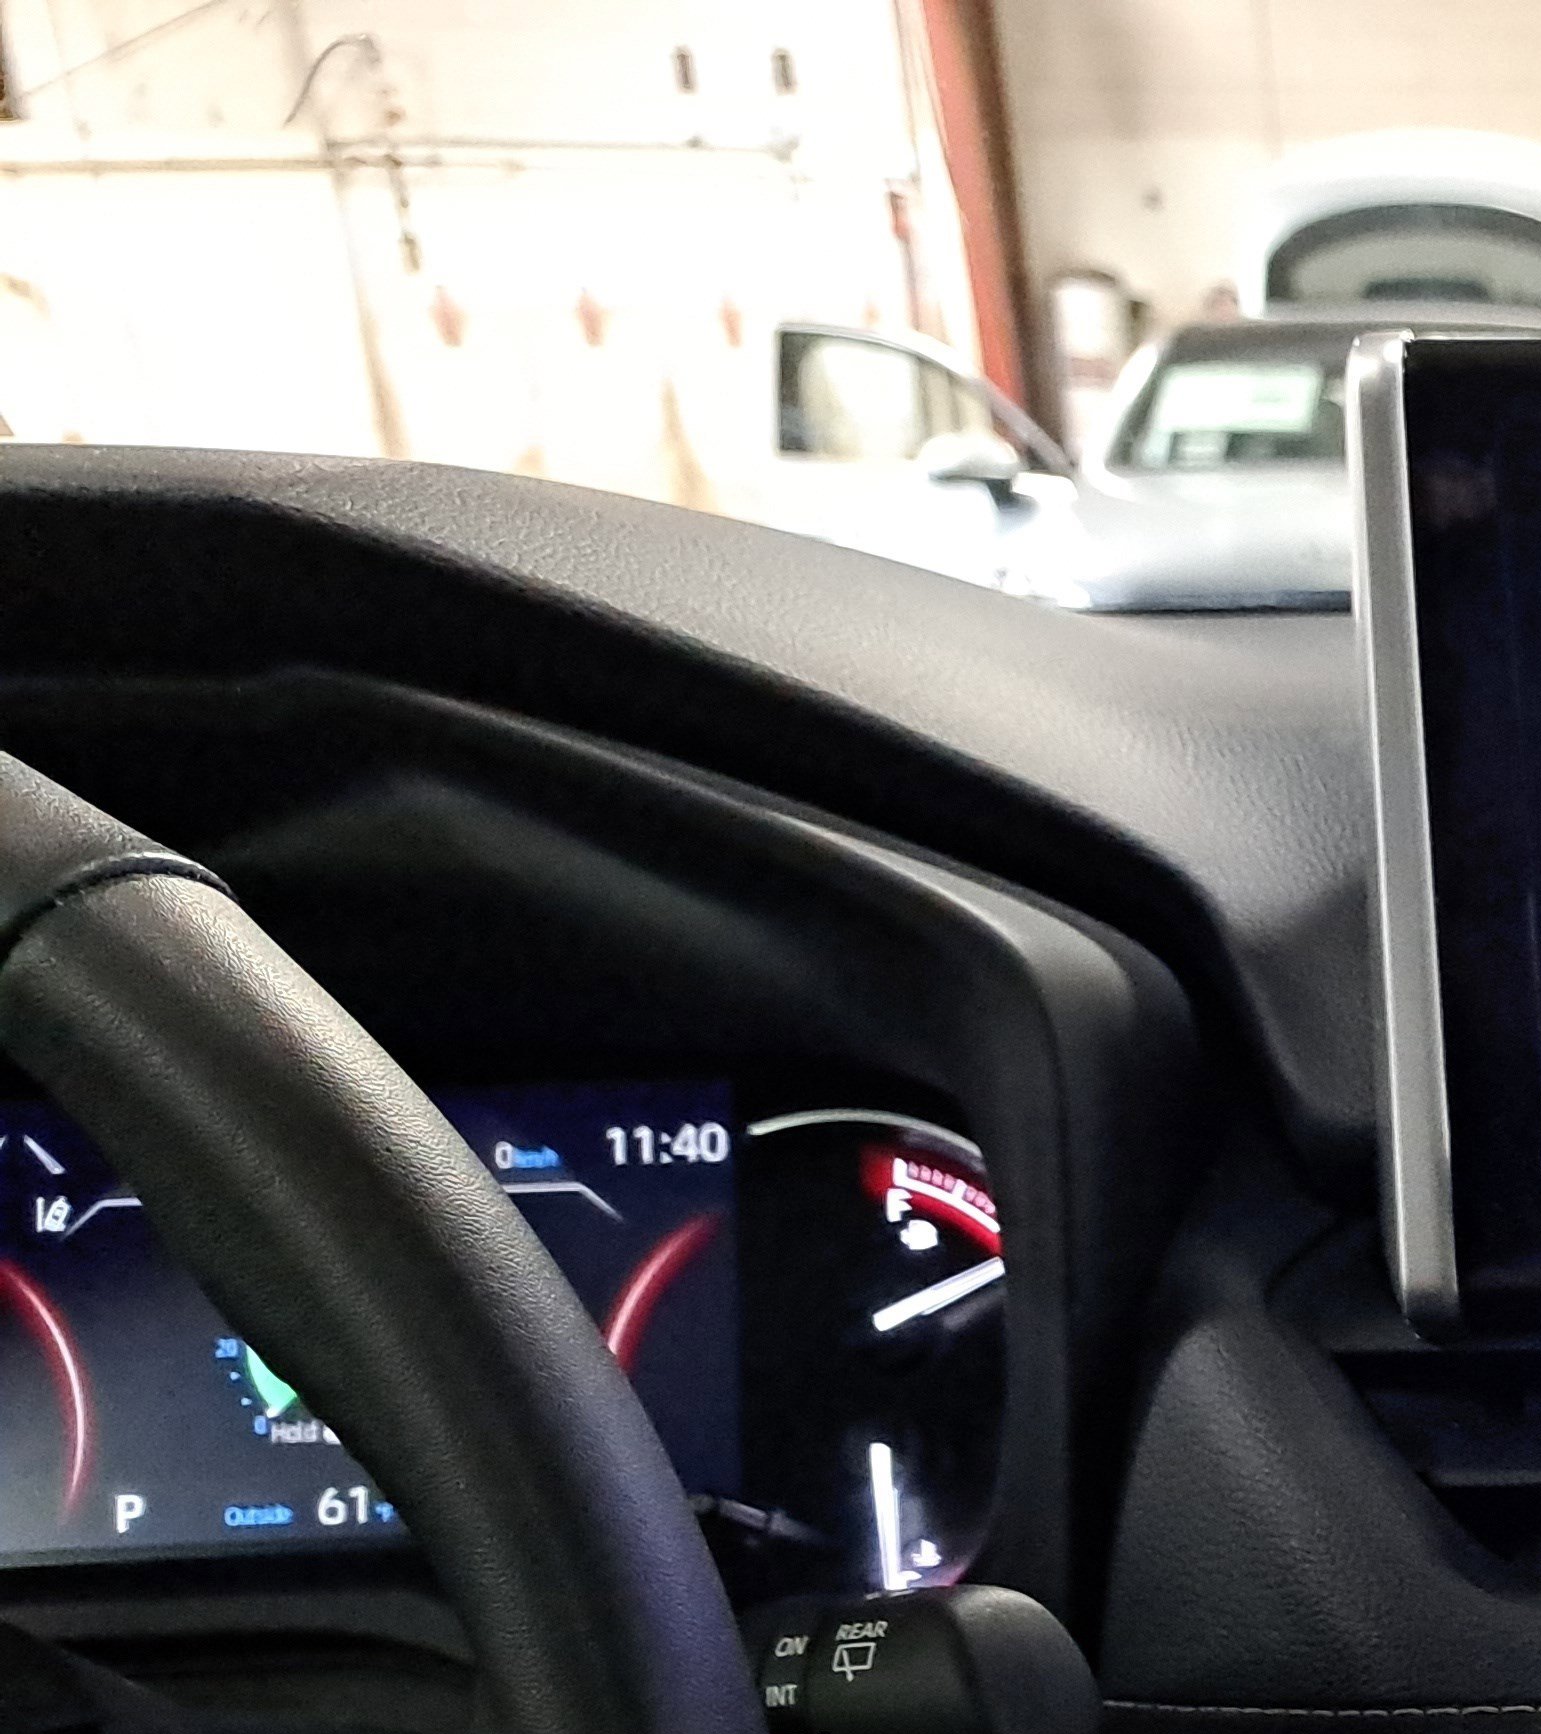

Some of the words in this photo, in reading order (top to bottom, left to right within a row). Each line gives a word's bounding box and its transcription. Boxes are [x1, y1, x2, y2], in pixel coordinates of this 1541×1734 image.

[605, 1121, 729, 1167] 11:40
[115, 1494, 146, 1533] P
[318, 1486, 369, 1525] 61
[775, 1635, 810, 1657] ON
[835, 1620, 888, 1641] REAR
[765, 1684, 798, 1707] INT
